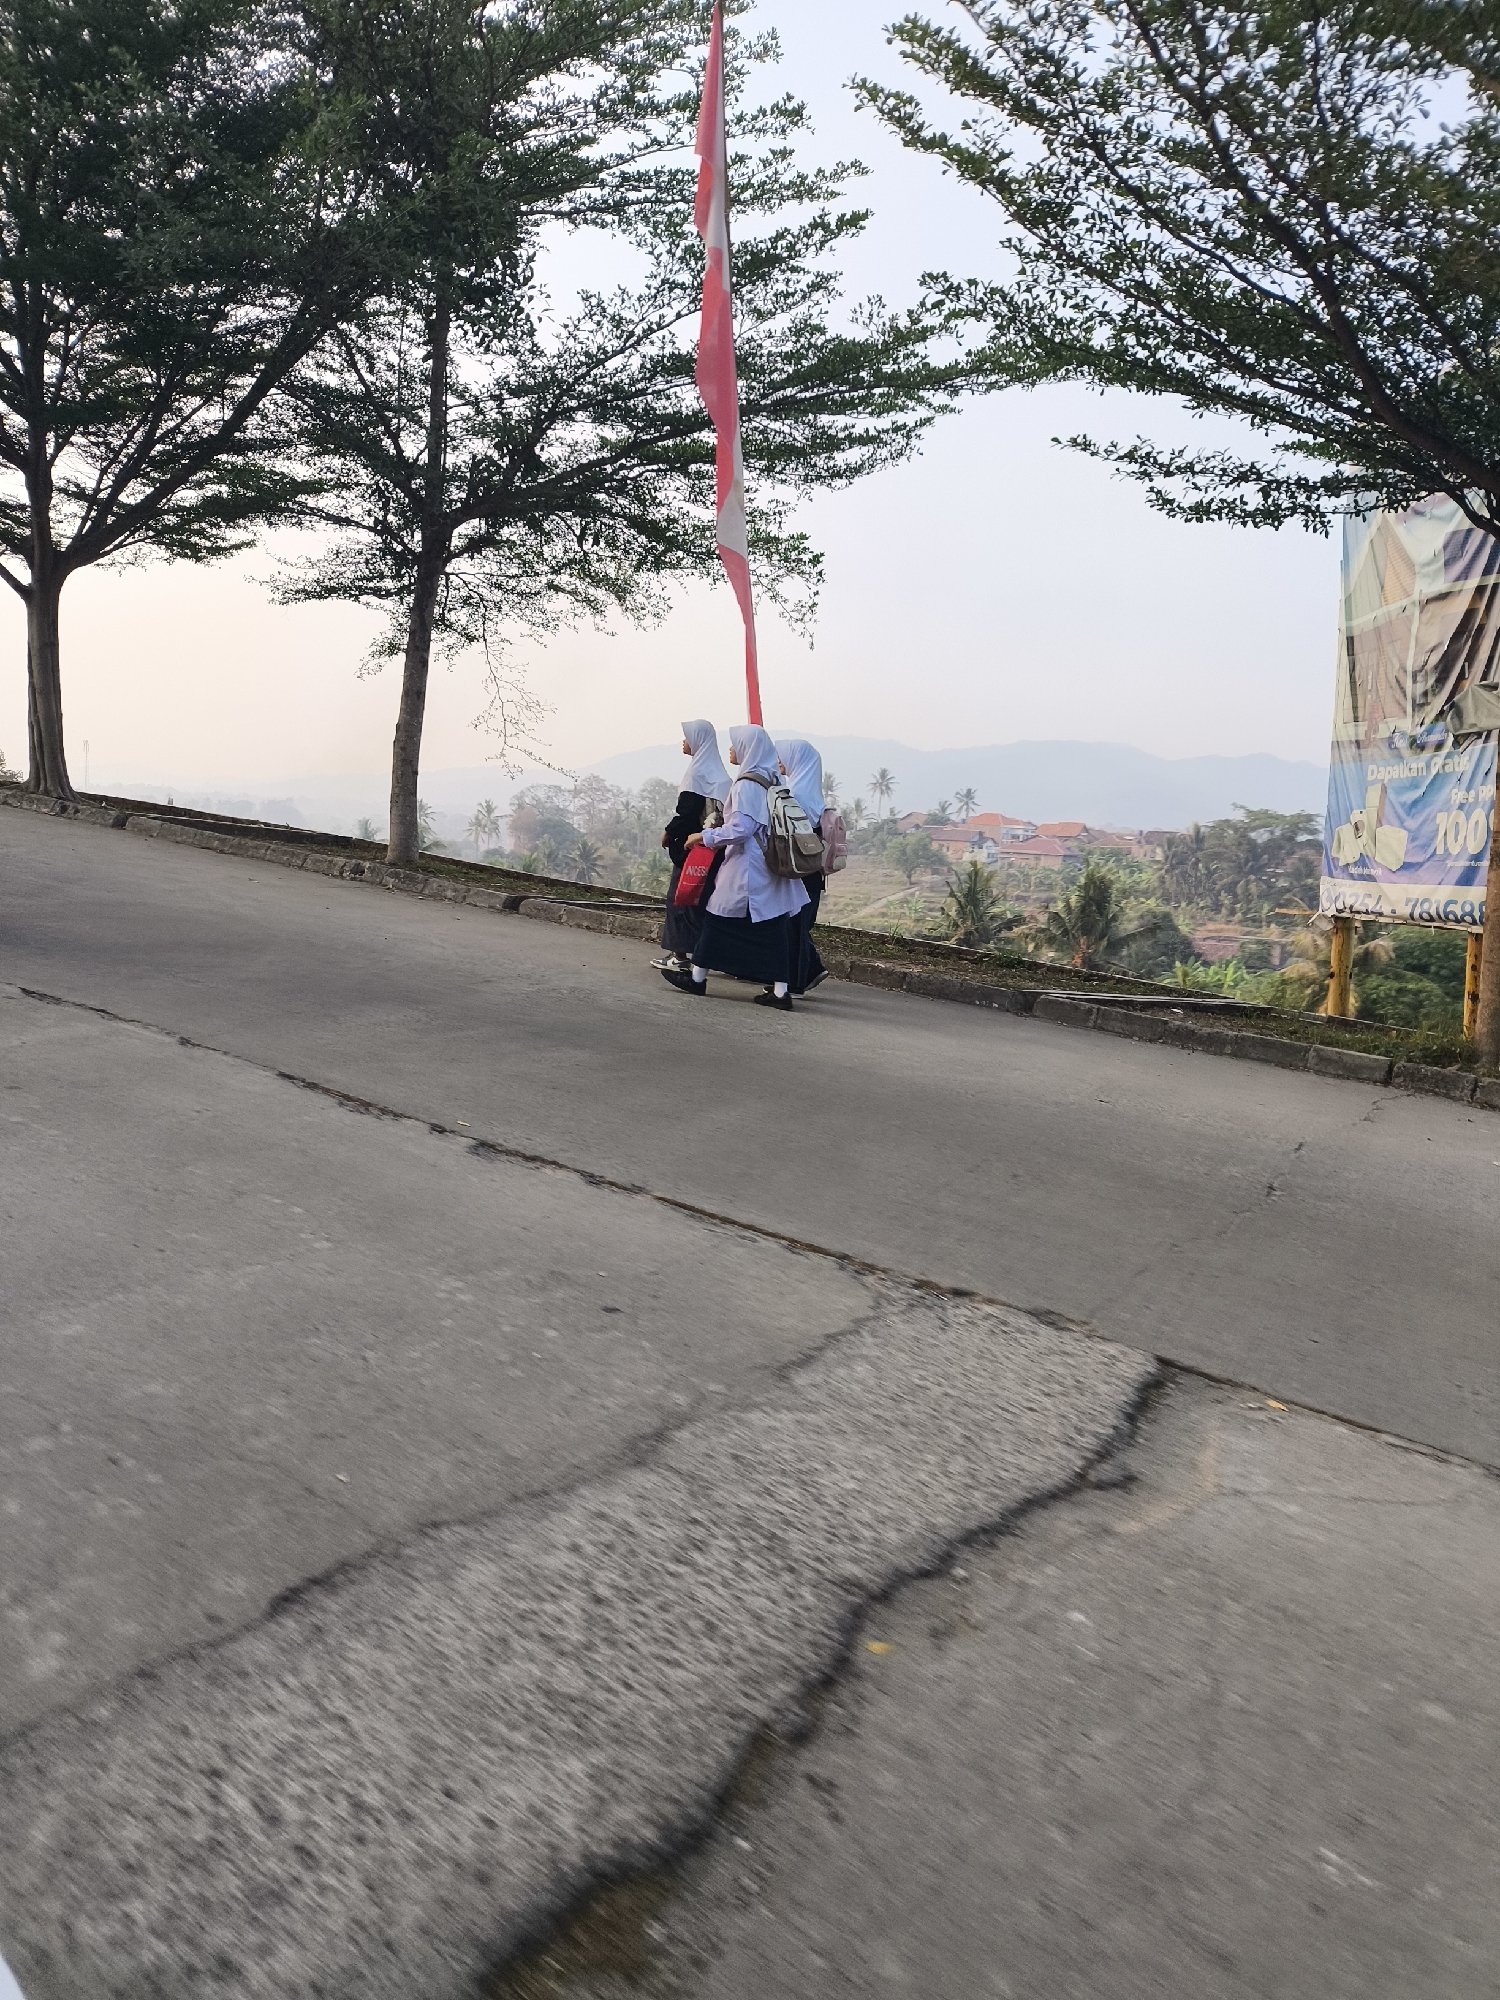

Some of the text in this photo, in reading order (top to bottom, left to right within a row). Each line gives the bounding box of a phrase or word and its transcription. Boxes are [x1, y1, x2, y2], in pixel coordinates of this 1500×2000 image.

[1367, 754, 1470, 783] Dapatkan Gratis
[1451, 788, 1475, 805] Free
